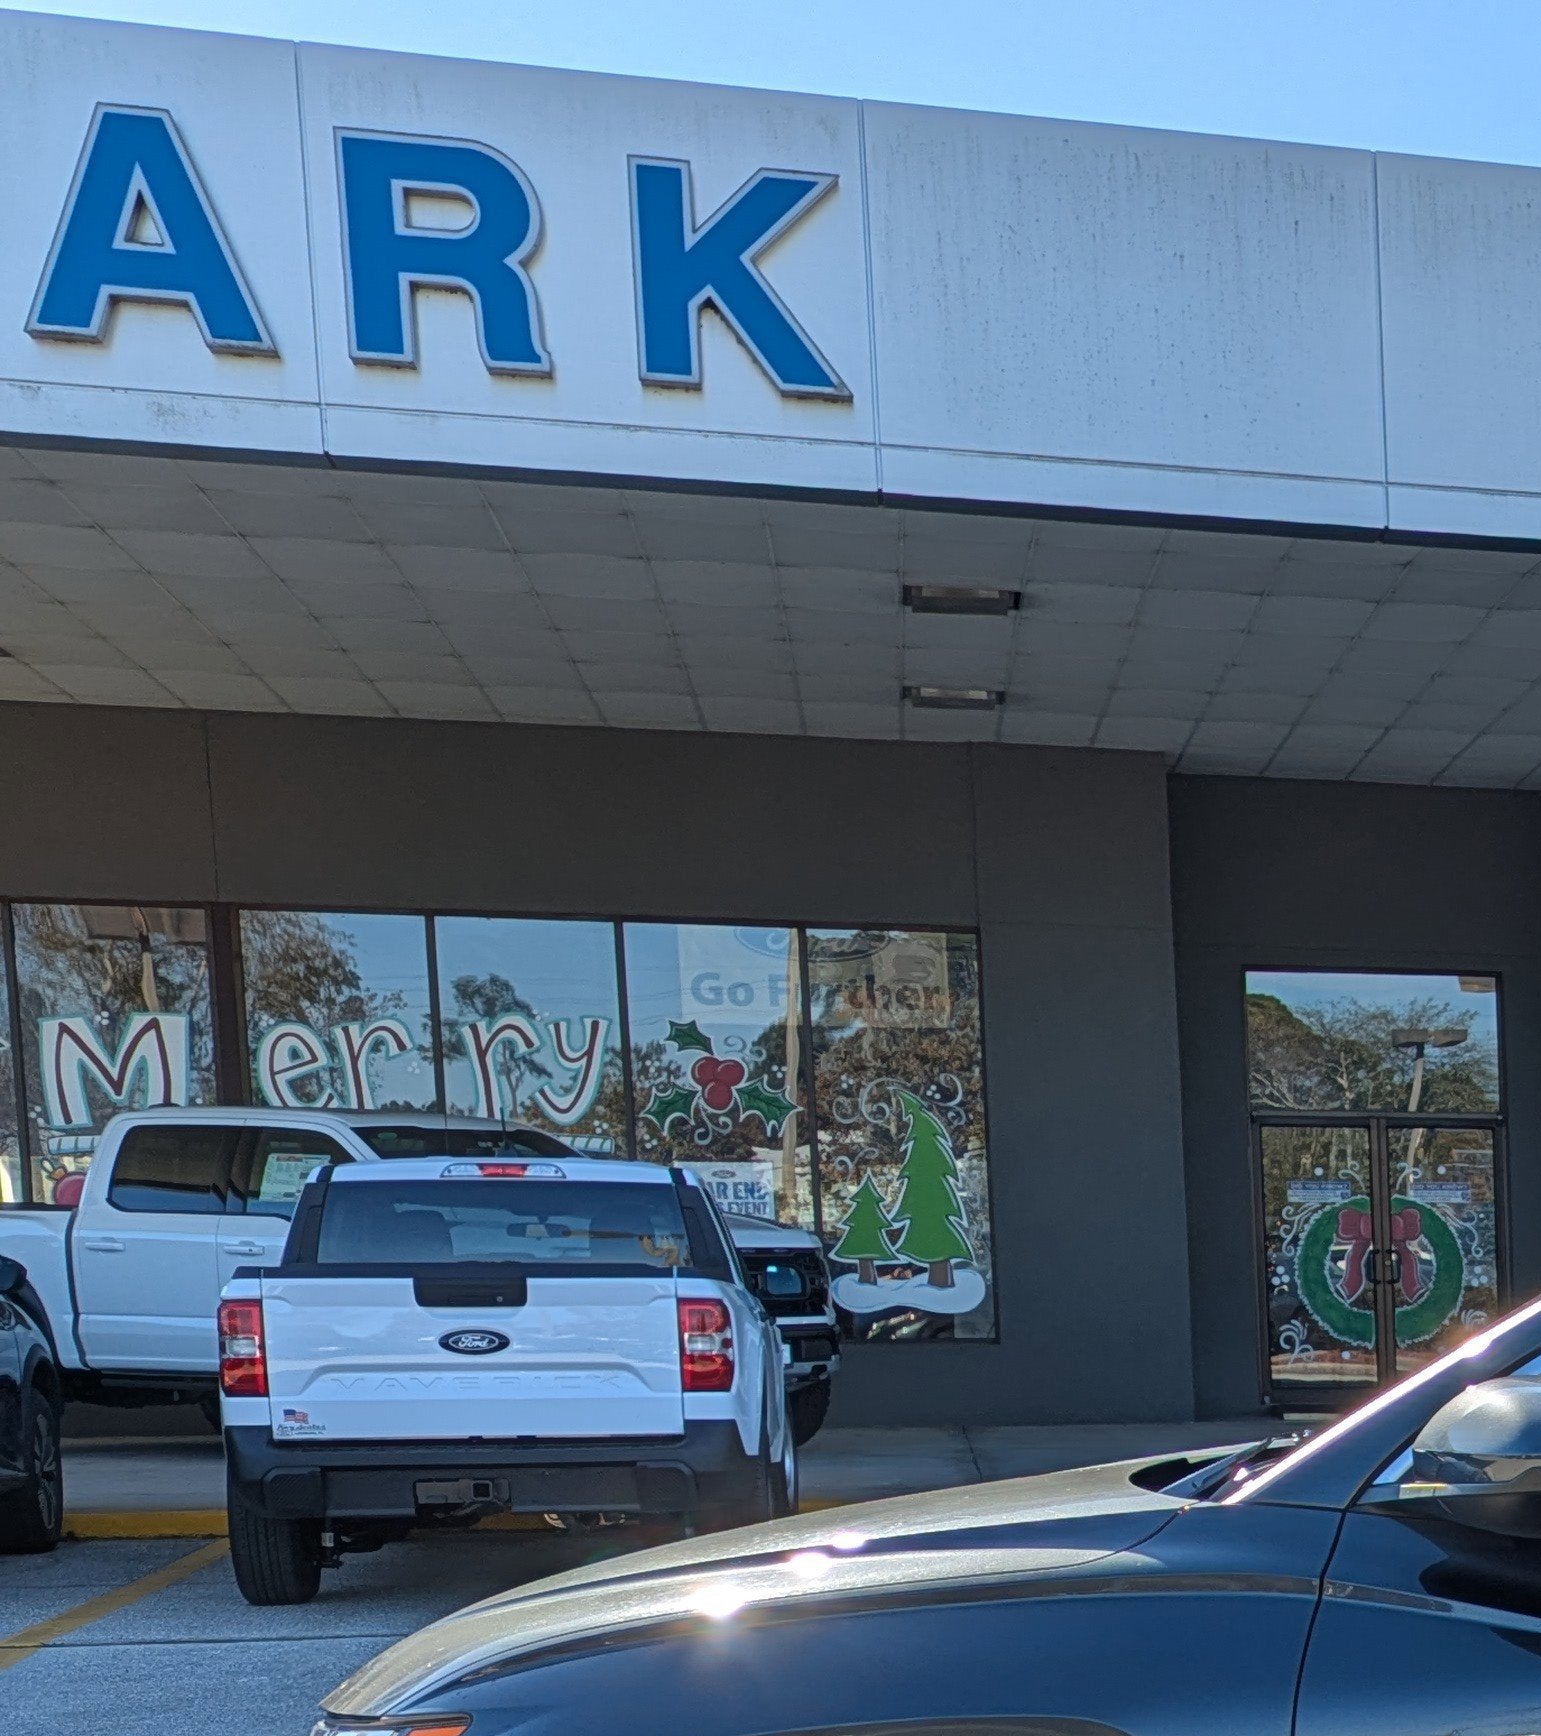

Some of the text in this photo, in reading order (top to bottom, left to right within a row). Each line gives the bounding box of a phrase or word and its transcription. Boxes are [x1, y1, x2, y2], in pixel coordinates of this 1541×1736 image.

[25, 103, 854, 403] ARK
[768, 973, 959, 1012] Frther
[40, 1010, 610, 1127] Merry
[458, 1335, 490, 1348] Ford
